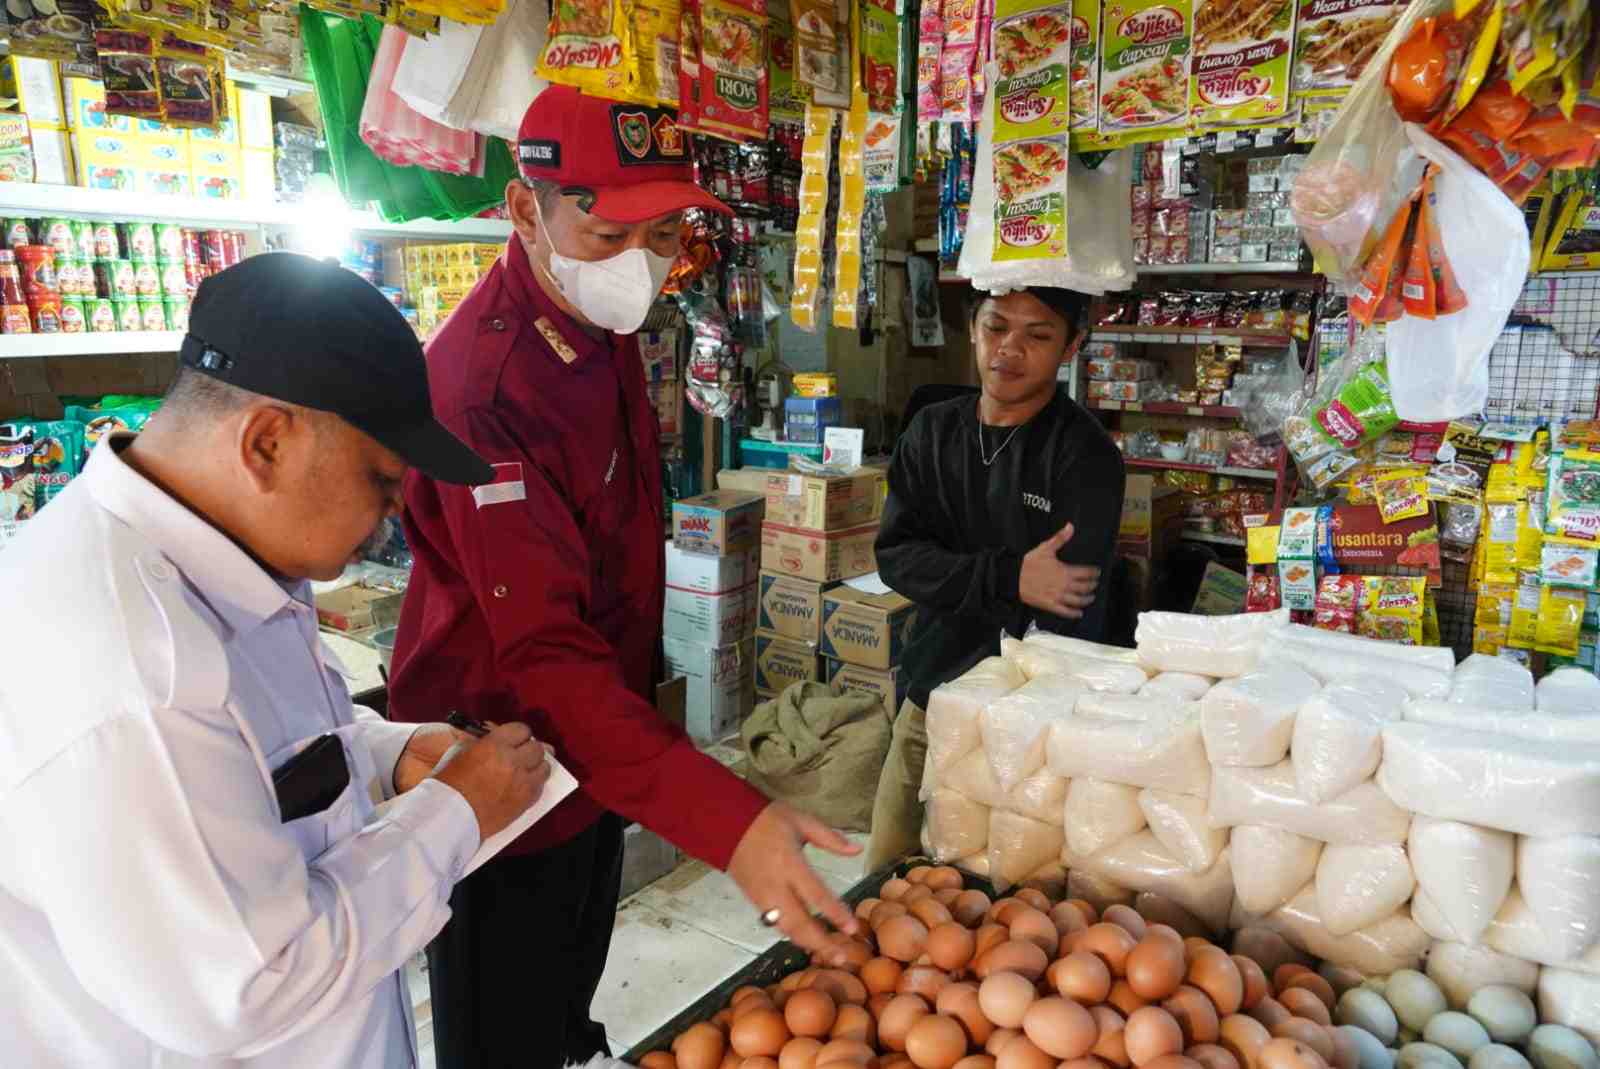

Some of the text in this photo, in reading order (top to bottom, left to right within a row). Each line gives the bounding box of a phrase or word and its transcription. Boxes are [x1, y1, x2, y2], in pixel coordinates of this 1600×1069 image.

[1124, 12, 1177, 43] Sajiku
[546, 43, 621, 70] Masako
[1119, 43, 1171, 65] Capcay
[1200, 54, 1244, 69] Goreng
[719, 77, 758, 101] SAORI
[1008, 70, 1051, 92] Capcay
[1204, 68, 1260, 98] Sajiku
[1005, 89, 1047, 117] Sajiku
[1003, 215, 1046, 243] Sajiku
[832, 624, 880, 649] AMANDA
